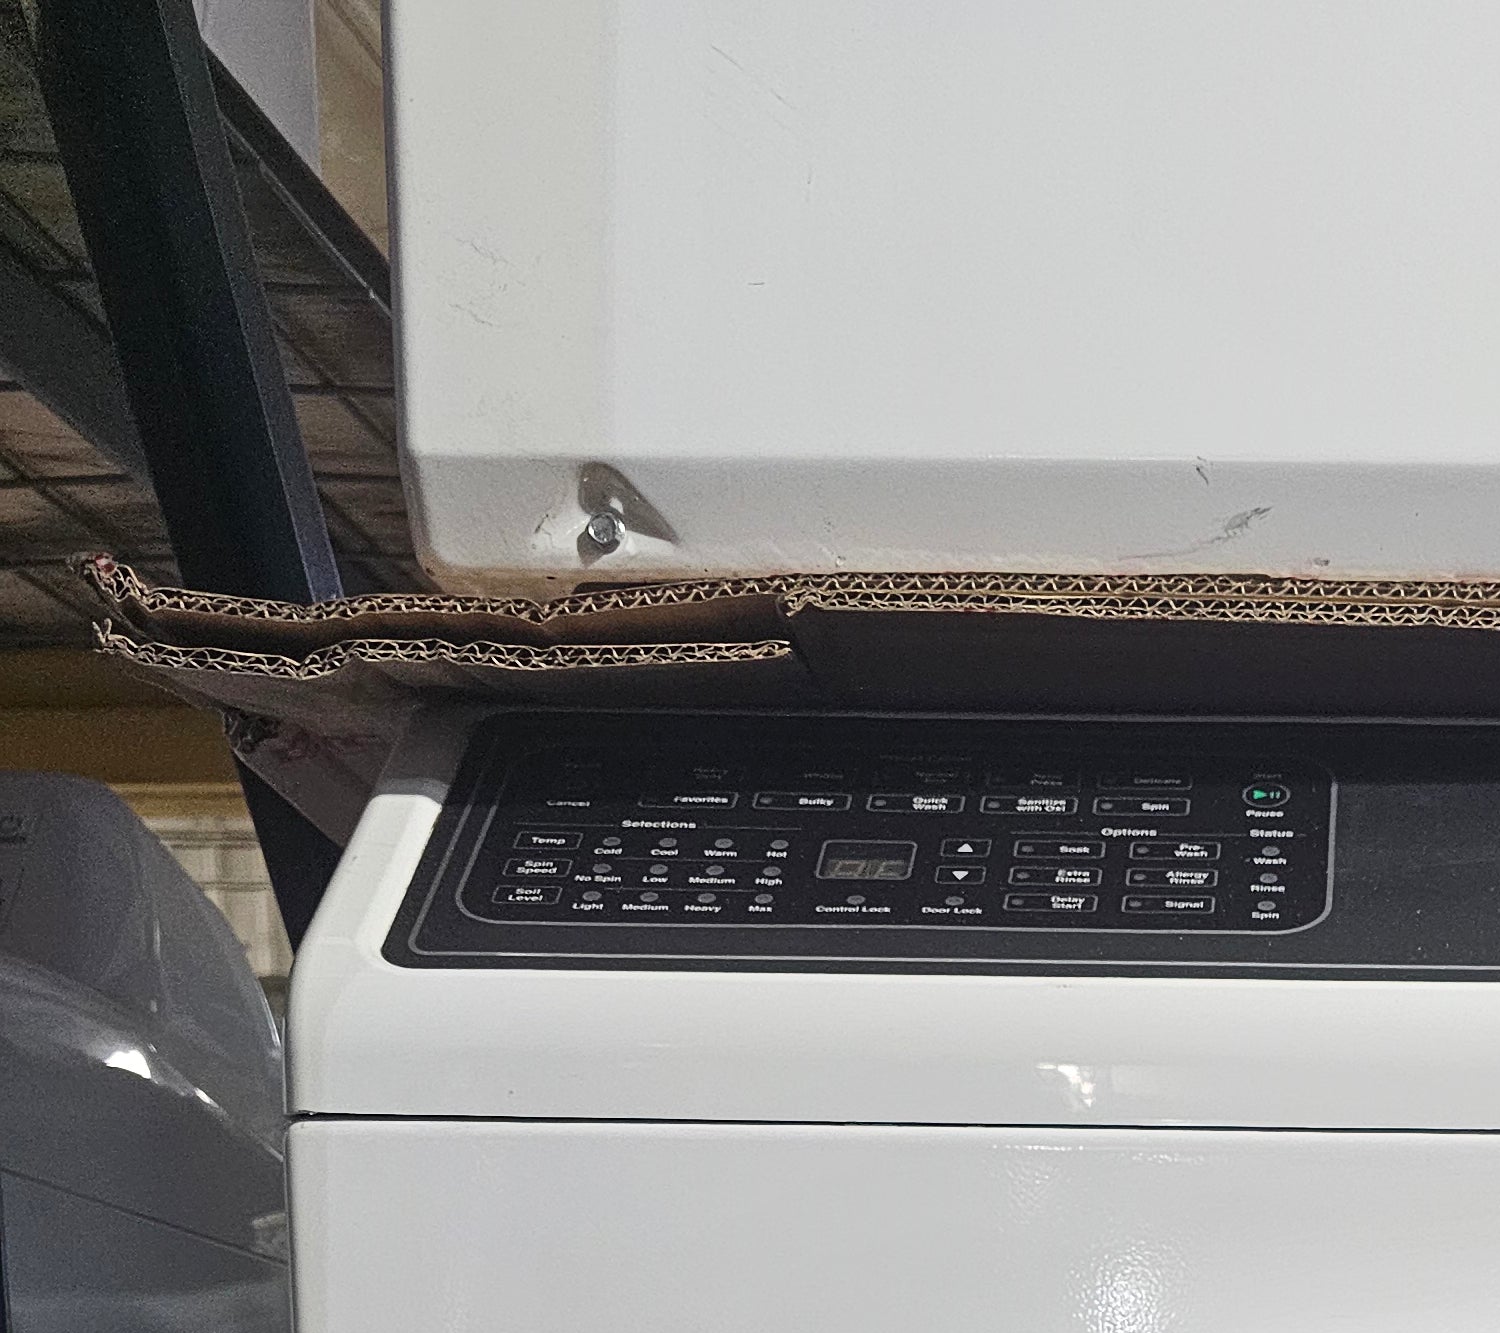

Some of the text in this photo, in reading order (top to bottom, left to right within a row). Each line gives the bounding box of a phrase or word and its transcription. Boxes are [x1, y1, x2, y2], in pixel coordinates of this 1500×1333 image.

[798, 797, 834, 806] Bulky
[912, 796, 948, 804] Quick
[1141, 802, 1169, 811] Spin
[621, 820, 697, 828] Selections
[1101, 827, 1157, 838] Options
[1250, 829, 1294, 837] Status
[532, 837, 566, 845] Temp
[650, 848, 678, 856] Cool
[1059, 845, 1090, 853] Soak
[1253, 857, 1287, 865] Wash
[594, 875, 621, 883] Spin
[688, 876, 736, 884] Medium
[754, 877, 783, 886] High
[1250, 884, 1286, 892] Rinse
[1165, 900, 1204, 908] Signal
[684, 904, 722, 913] Heavy
[1252, 911, 1279, 919] Spin
